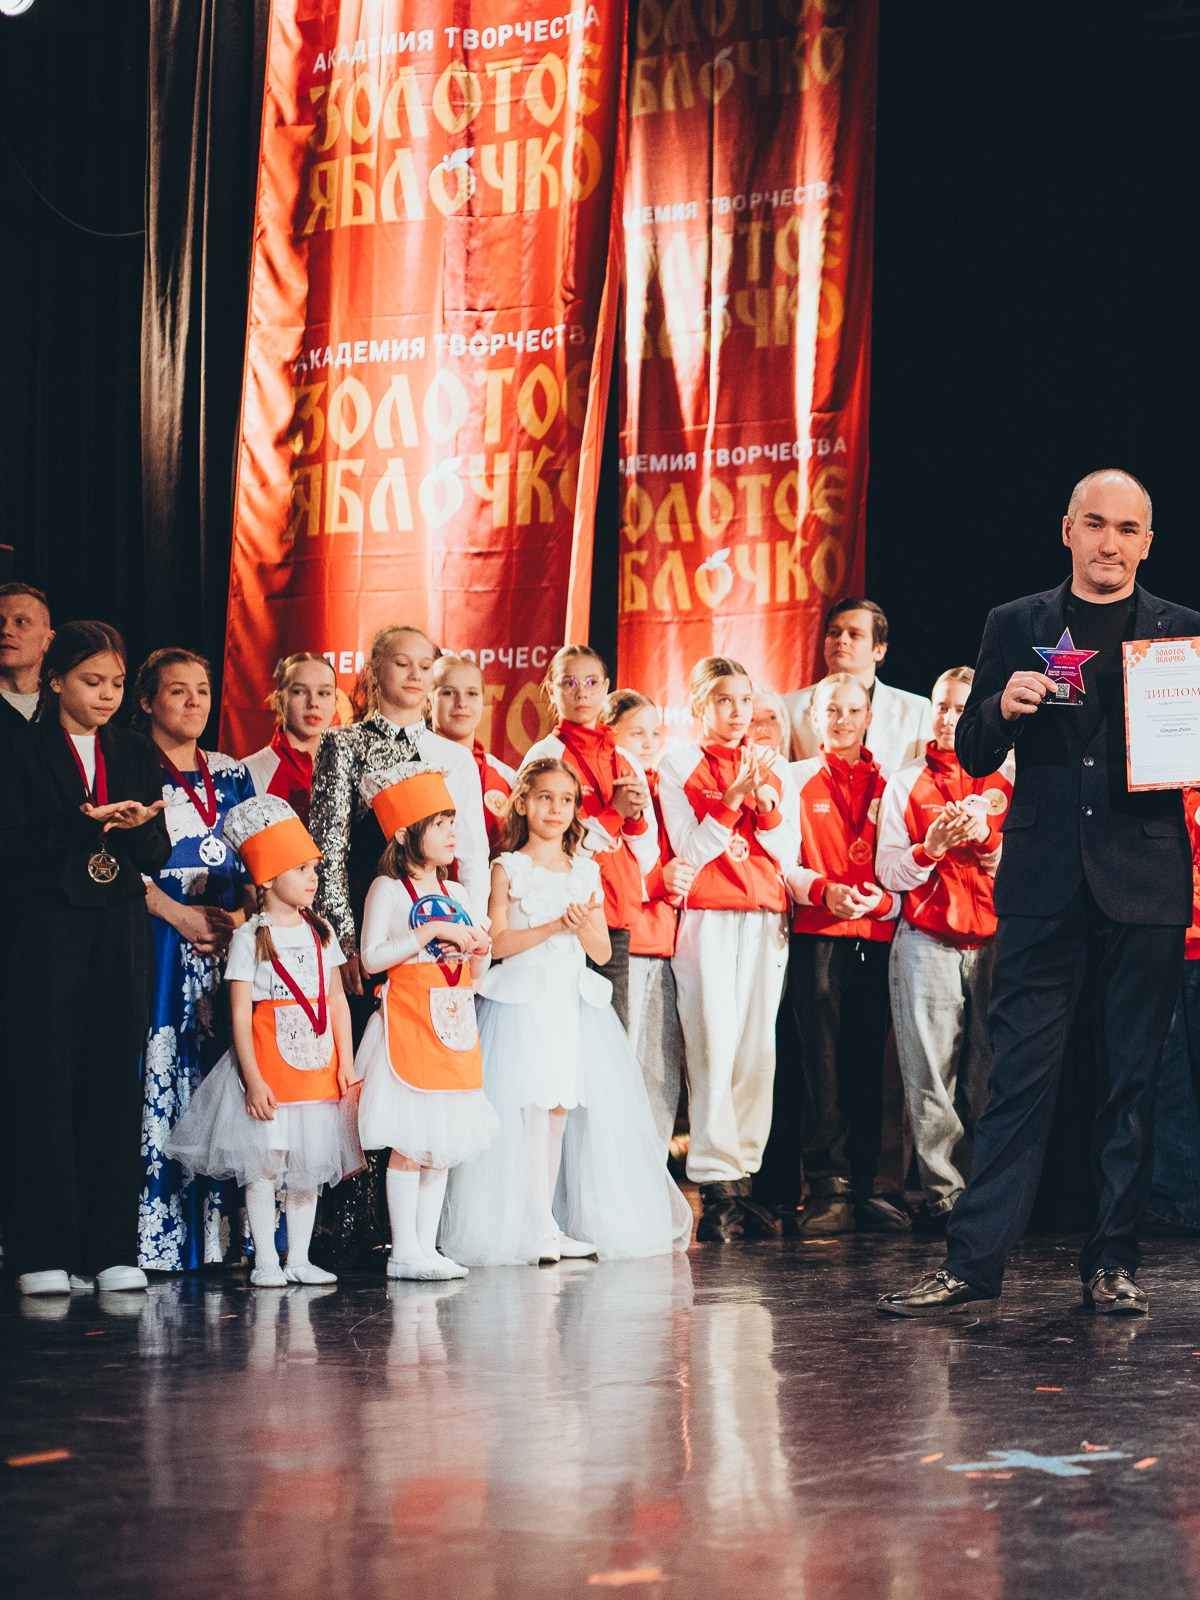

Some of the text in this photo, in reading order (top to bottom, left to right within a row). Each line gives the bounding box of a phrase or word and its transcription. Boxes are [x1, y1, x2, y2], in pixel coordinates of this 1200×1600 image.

[313, 5, 601, 74] АКАДЕМИЯ ТВОРЧЕСТВА
[308, 40, 602, 152] ЗОЛОТОЕ
[301, 125, 603, 236] ЯБЛОЧКО
[293, 324, 593, 371] АКАДЕМИЯ ТВОРЧЕСТВ
[704, 436, 847, 469] ТВОРЧЕСТВА
[1142, 687, 1200, 700] ДИПЛОМ
